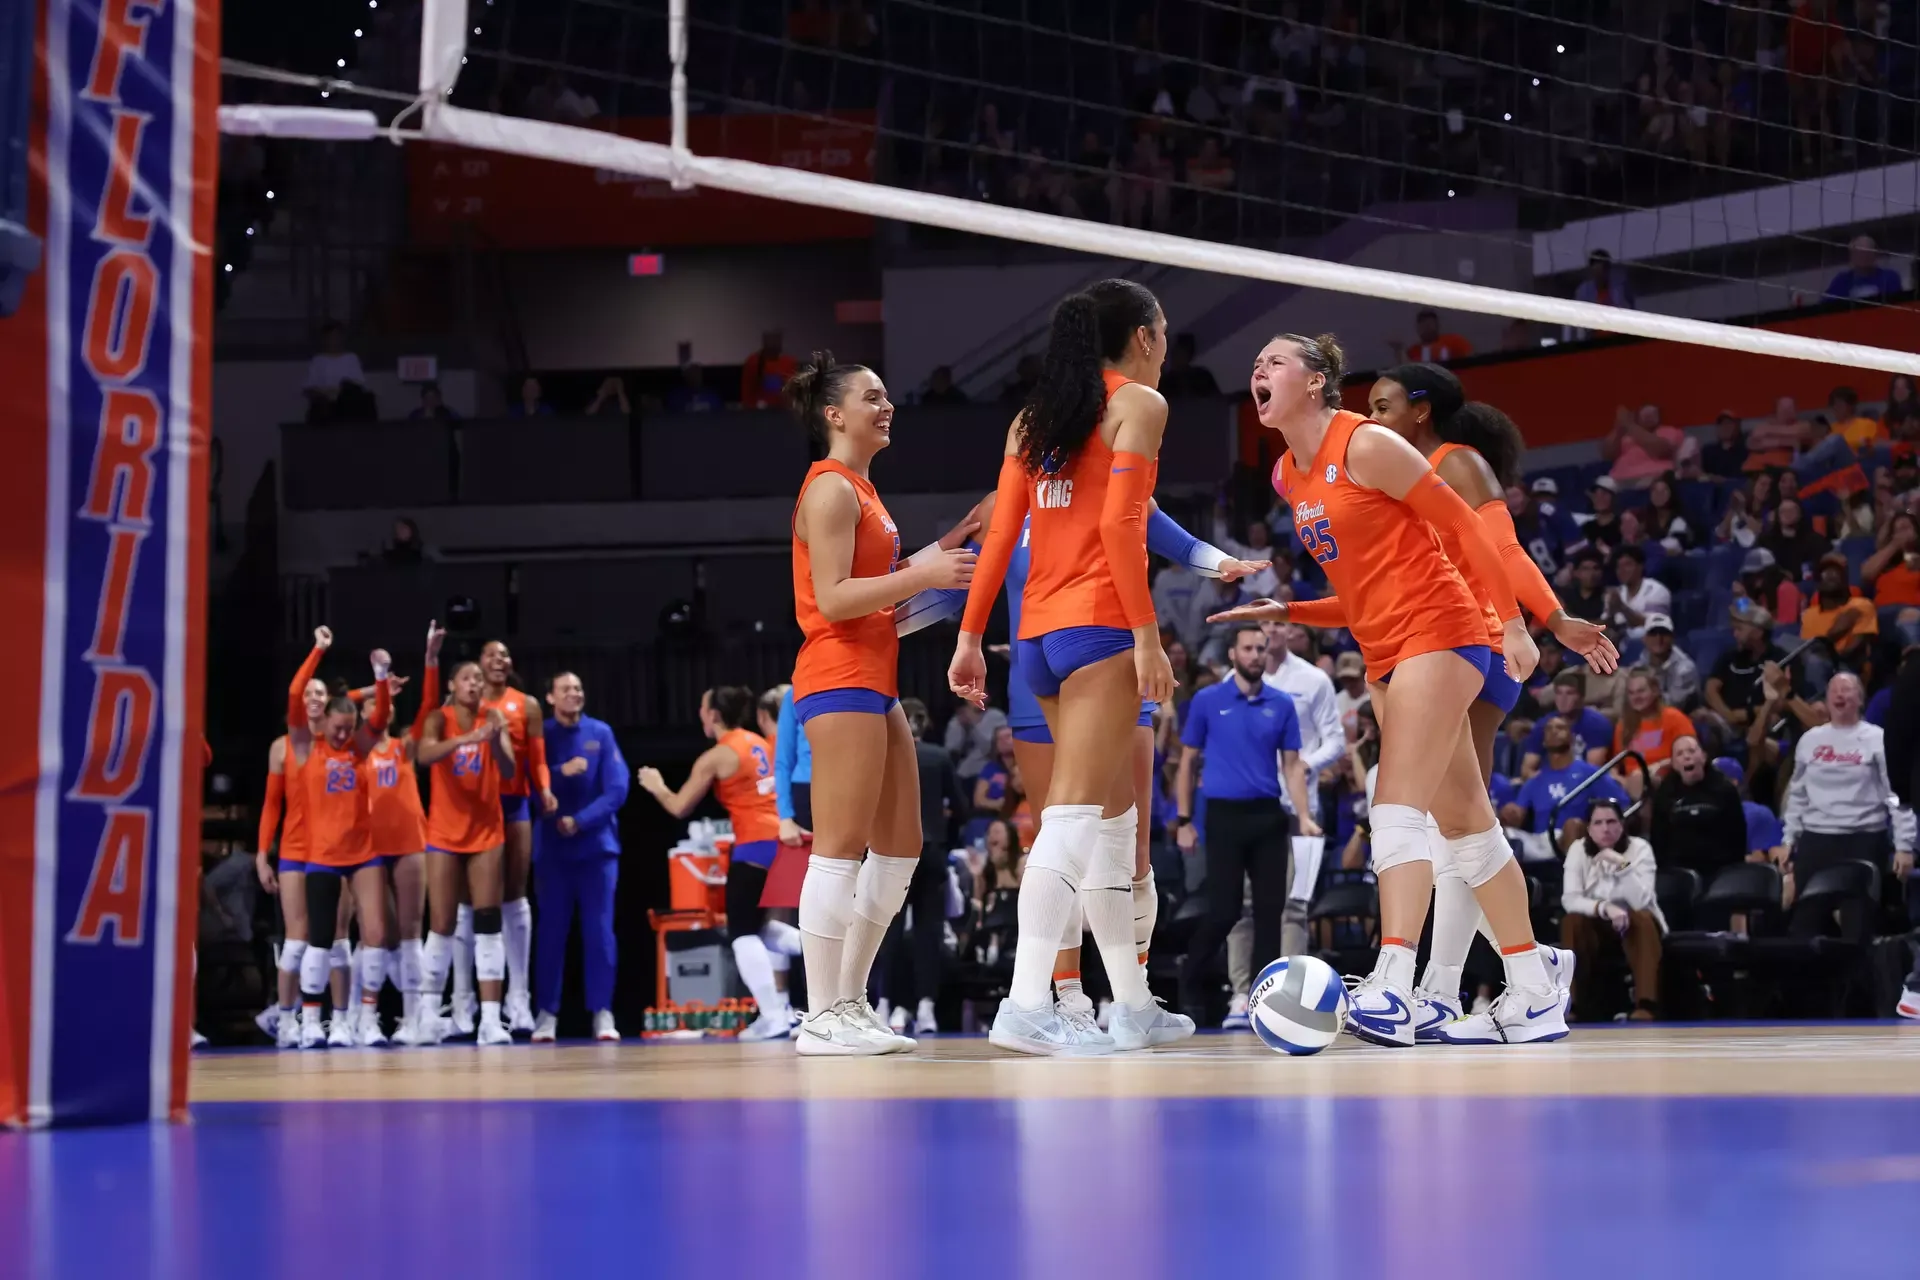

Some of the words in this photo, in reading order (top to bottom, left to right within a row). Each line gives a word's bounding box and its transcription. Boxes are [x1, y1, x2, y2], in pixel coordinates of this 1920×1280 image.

[64, 0, 164, 946] FLORIDA
[1036, 479, 1073, 509] KING
[1295, 499, 1325, 524] Florida
[1299, 518, 1340, 565] 25
[376, 766, 399, 788] 10
[453, 753, 483, 777] 24
[327, 767, 357, 793] 23
